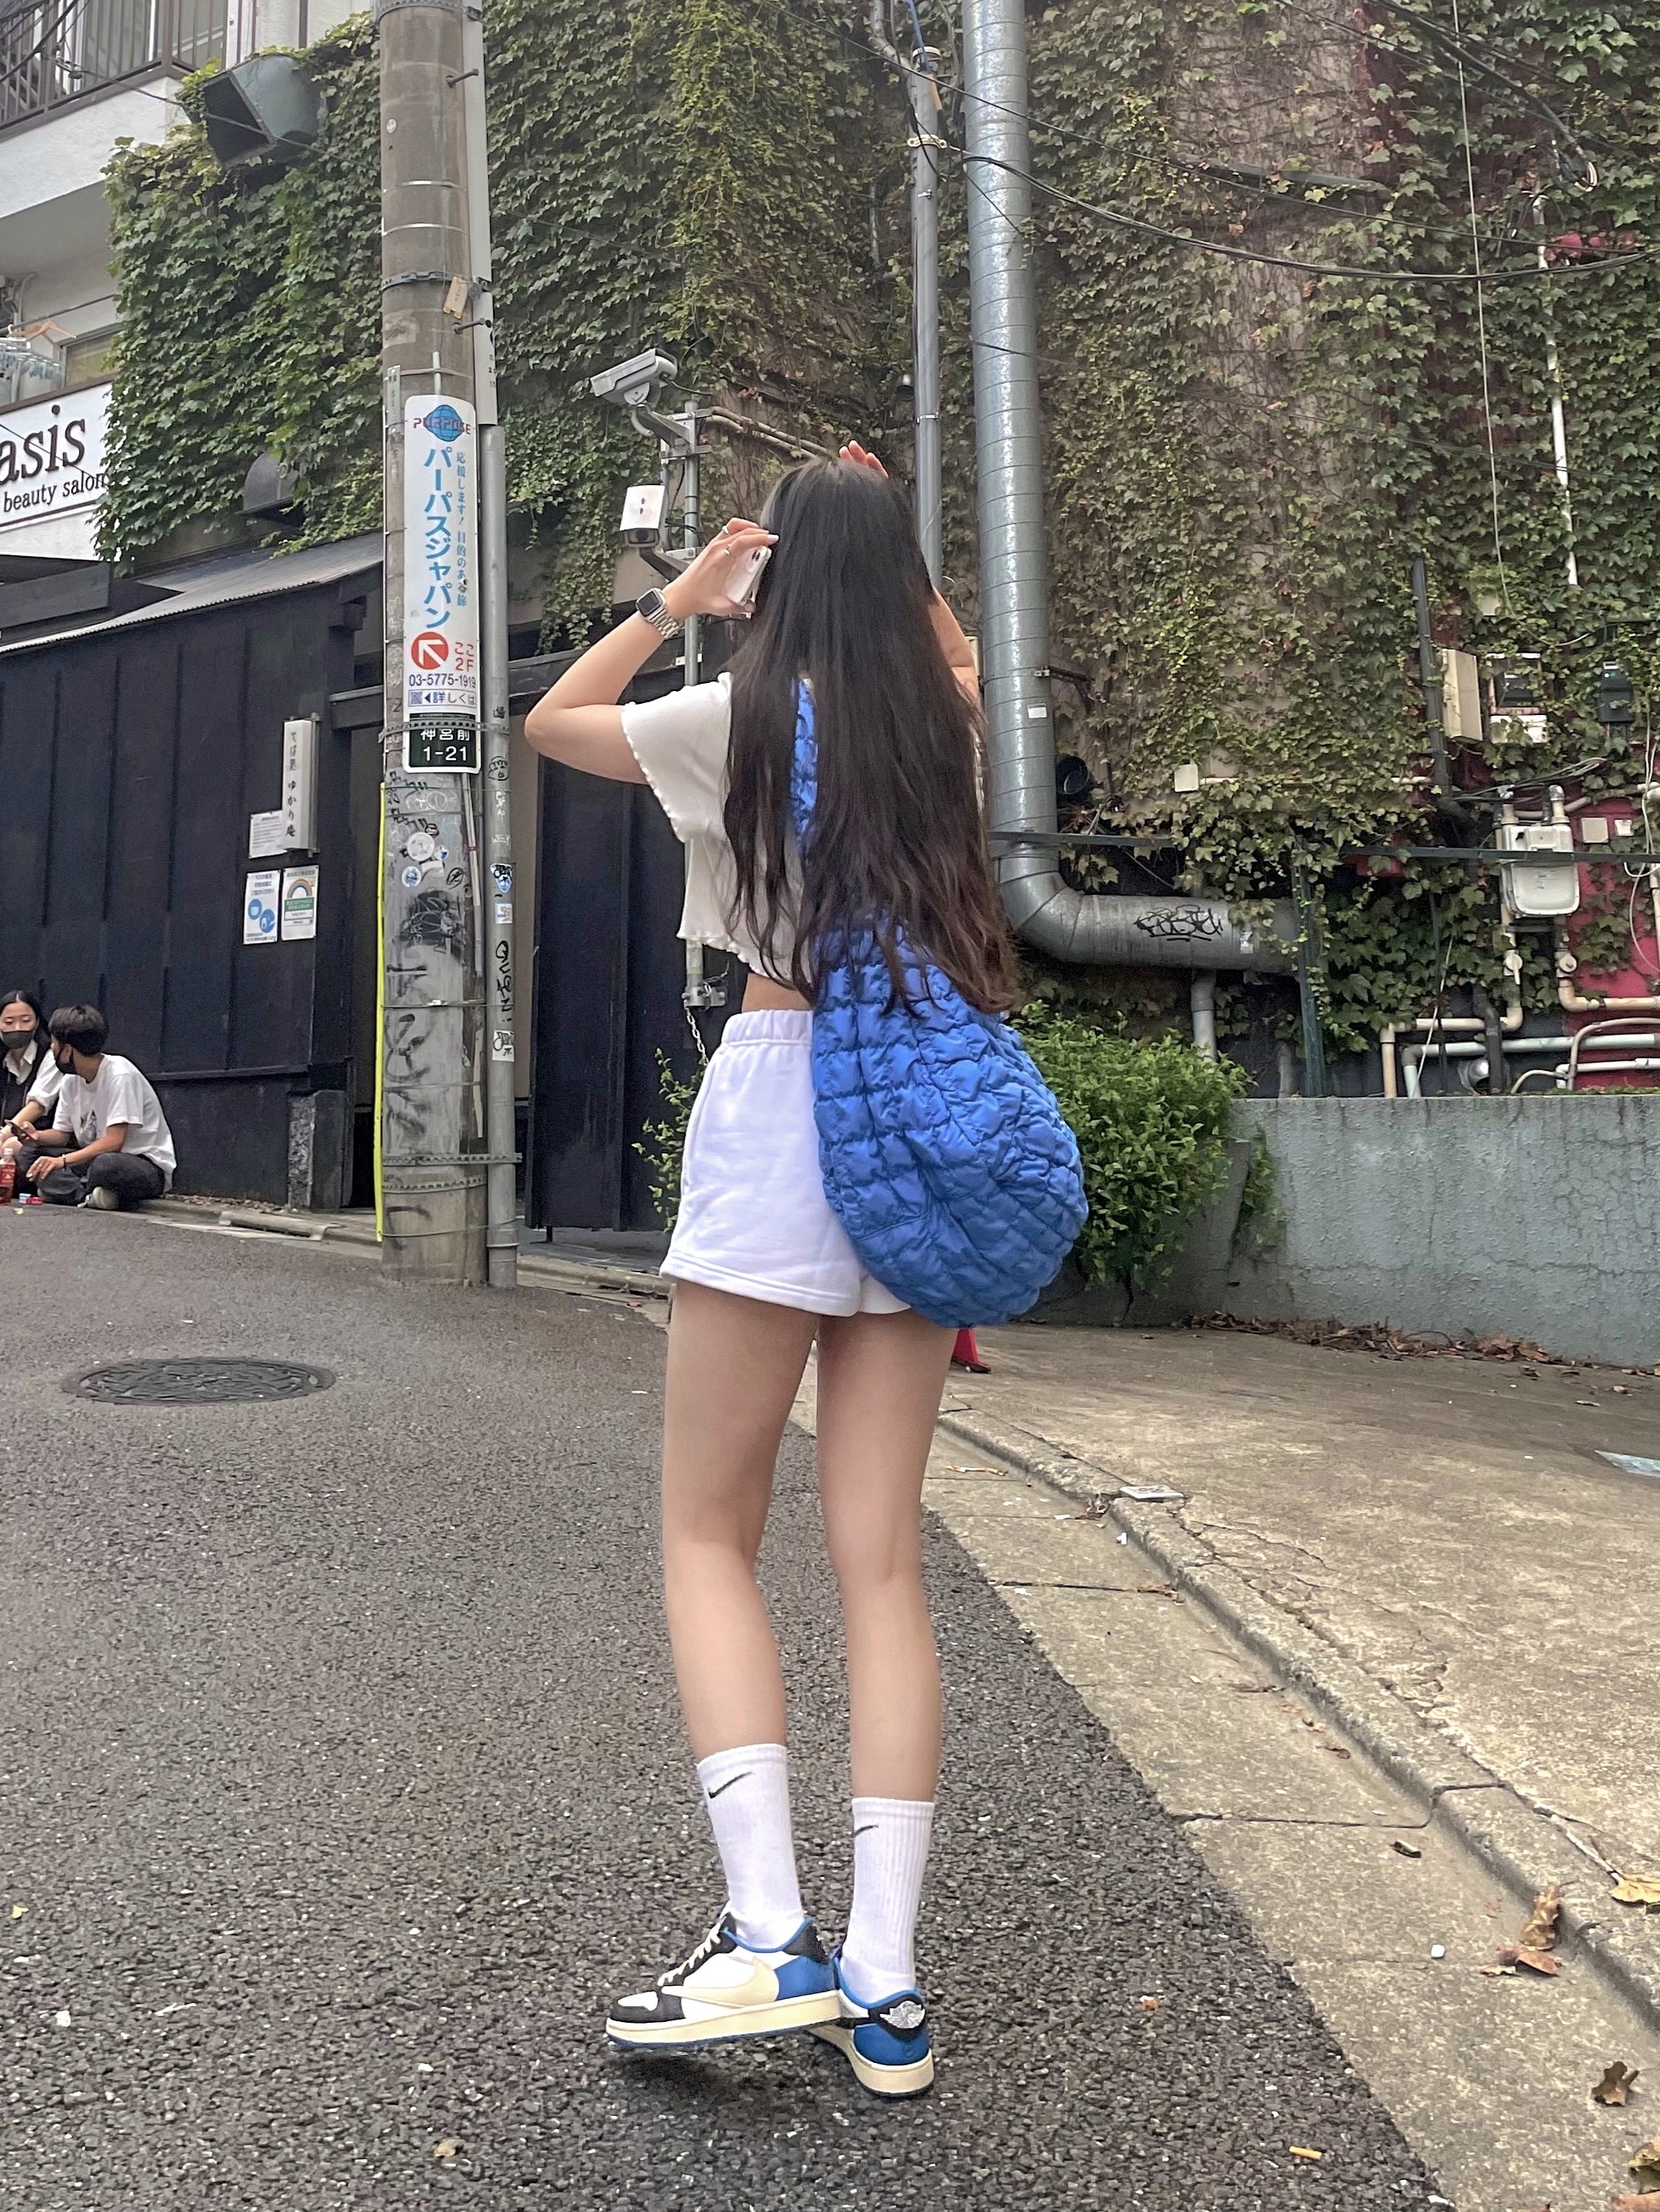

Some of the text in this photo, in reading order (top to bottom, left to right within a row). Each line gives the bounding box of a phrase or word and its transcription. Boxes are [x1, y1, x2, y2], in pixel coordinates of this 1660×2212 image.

[413, 417, 472, 435] PURPOSE
[3, 470, 107, 512] beauty salon
[423, 447, 453, 629] パーパスジャパン
[454, 641, 475, 657] ここ
[455, 657, 474, 673] 2F
[409, 673, 476, 689] 03-5775-1919
[423, 746, 467, 762] 1-21
